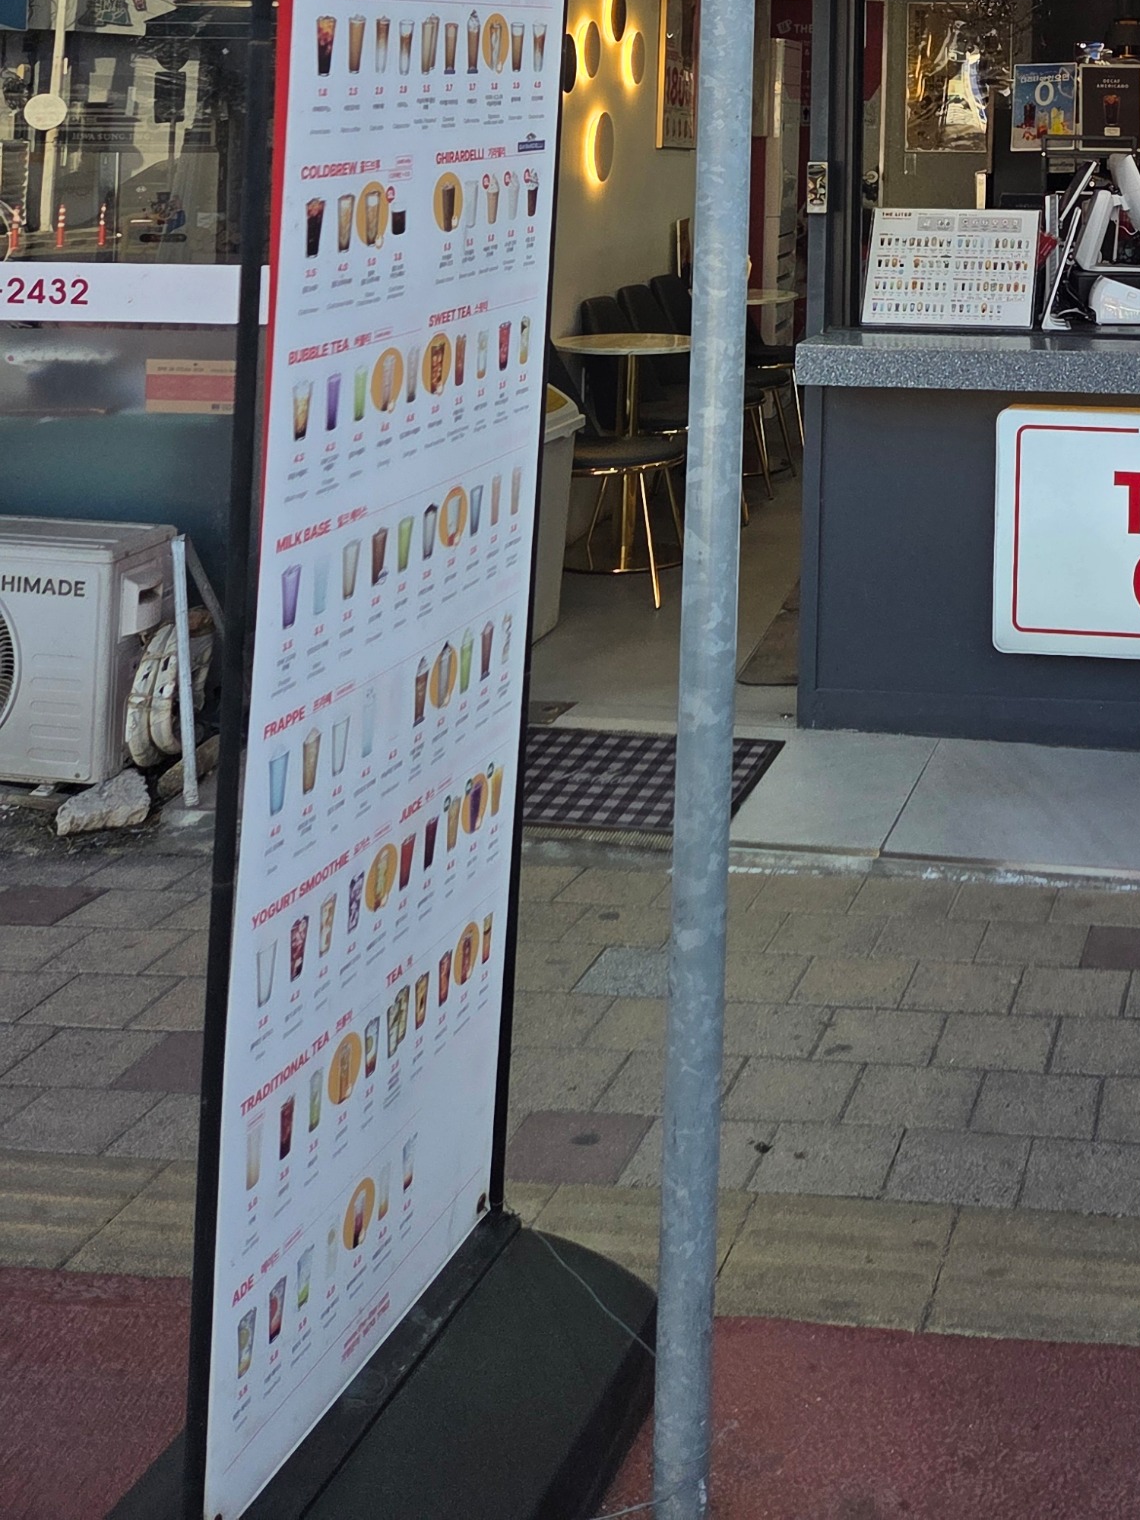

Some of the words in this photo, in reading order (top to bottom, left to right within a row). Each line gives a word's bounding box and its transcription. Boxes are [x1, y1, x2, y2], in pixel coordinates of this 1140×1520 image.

[301, 161, 358, 180] COLDBREW
[436, 149, 484, 165] GHIRARDELLI
[0, 278, 89, 306] 2432
[428, 308, 456, 328] SWEET
[455, 304, 472, 319] TEA
[287, 341, 331, 366] BUBBLE
[330, 337, 350, 352] TEA
[276, 532, 302, 554] MILK
[301, 519, 332, 540] BASE
[1, 574, 86, 598] HIMADE
[263, 705, 305, 740] FRAPPE
[399, 795, 423, 824] JUICE
[251, 886, 297, 930] YOGURT
[298, 849, 350, 898] SMOOTHIE
[385, 964, 403, 987] TEA
[240, 1049, 311, 1117] TRADITIONAL
[311, 1031, 330, 1058] TEA
[232, 1274, 255, 1308] ADE
